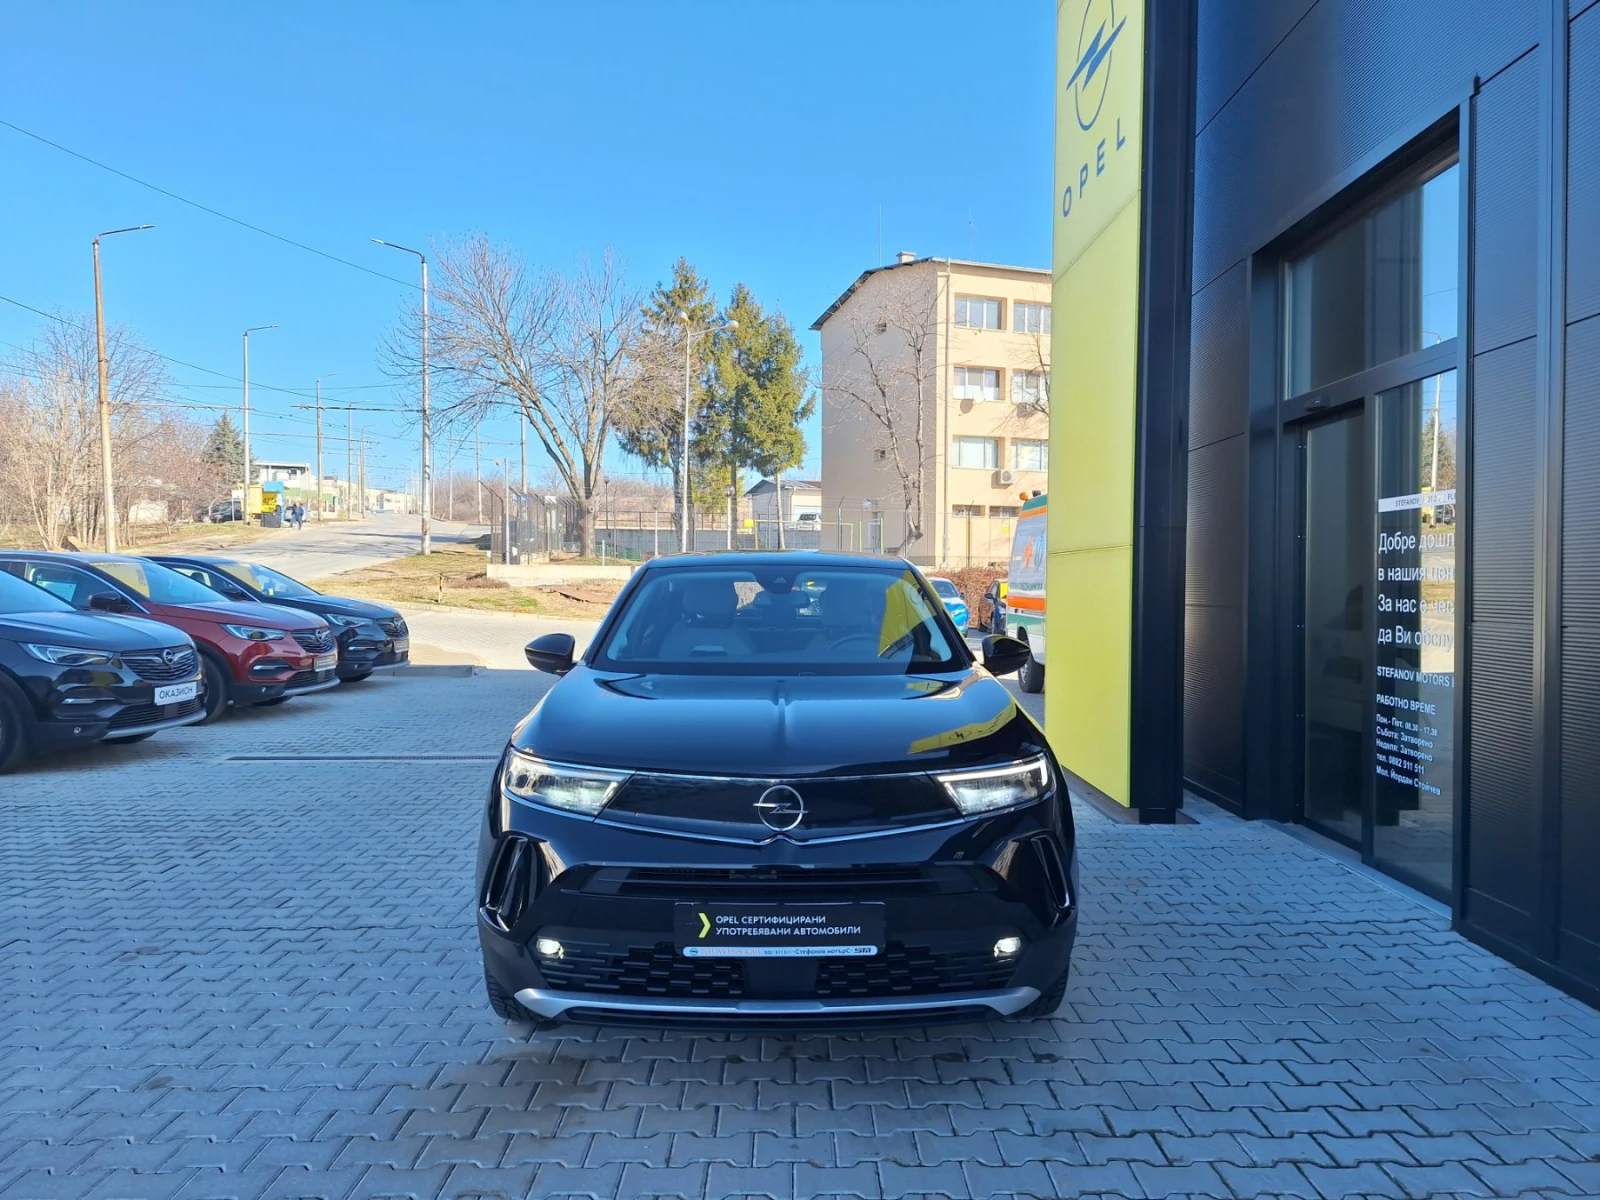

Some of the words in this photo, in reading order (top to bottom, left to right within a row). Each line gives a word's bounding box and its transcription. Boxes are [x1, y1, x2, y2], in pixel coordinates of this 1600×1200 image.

[1062, 117, 1126, 218] OPEL
[1378, 531, 1416, 554] Добре
[1378, 567, 1385, 581] в
[1387, 567, 1427, 581] нашия
[1378, 593, 1392, 612] За
[1395, 598, 1417, 613] нас
[1420, 599, 1428, 613] е
[1377, 628, 1392, 645] да
[1395, 625, 1412, 645] Ви
[1376, 665, 1415, 681] STEFANOV
[1415, 671, 1450, 687] MOTORS
[159, 687, 193, 699] ОКАЗИОН
[1376, 693, 1409, 709] РАБОТНО
[1410, 700, 1436, 715] ВРЕМЕ
[1400, 732, 1433, 749] Затворено
[1400, 744, 1433, 761] Затворено
[1403, 760, 1413, 771] 511
[1414, 764, 1425, 775] 511
[715, 915, 739, 924] OPEL
[741, 915, 826, 925] СЕРТИФИЦИРАНИ
[715, 927, 791, 936] УПОТРЕБЯВАНИ
[793, 926, 861, 936] АВТОМОБИЛИ
